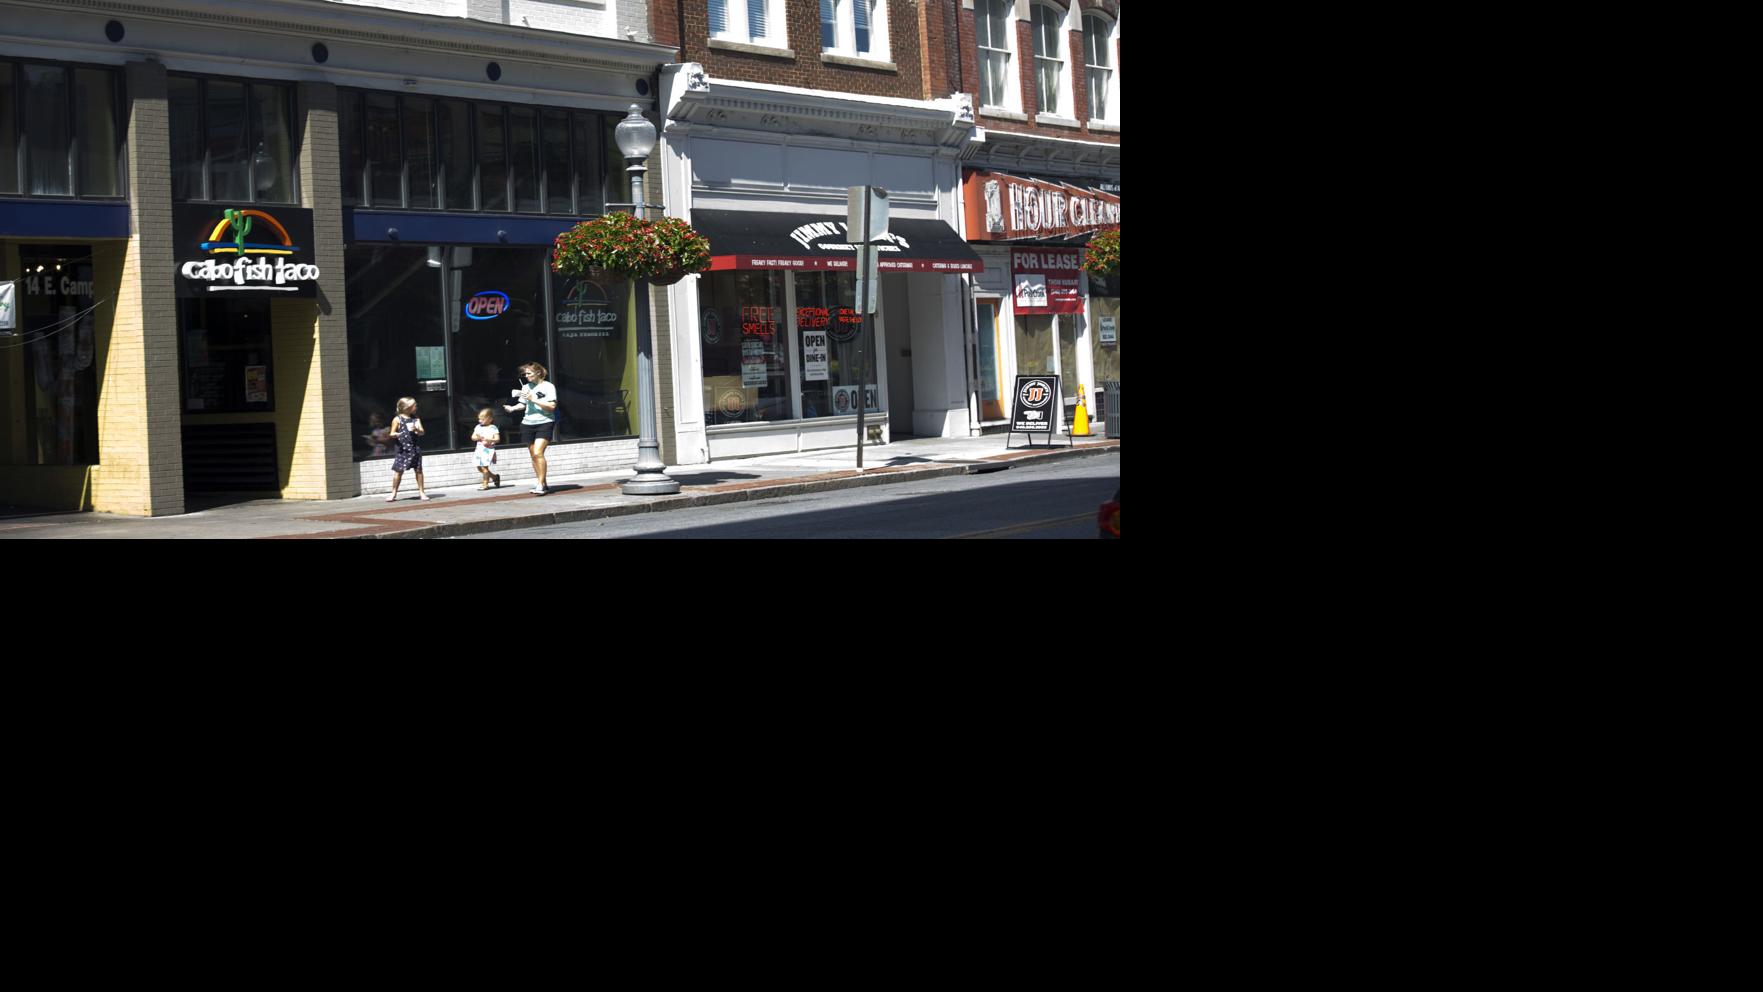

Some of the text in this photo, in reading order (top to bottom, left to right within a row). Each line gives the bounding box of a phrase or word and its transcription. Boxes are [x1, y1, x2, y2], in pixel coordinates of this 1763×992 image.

[984, 180, 1005, 233] 1
[1008, 183, 1067, 231] HOUR
[789, 221, 841, 250] JIMMY
[1013, 252, 1079, 270] FOR LEASE
[181, 256, 320, 285] cabo fish taco
[25, 275, 40, 295] 14
[44, 276, 57, 295] E.
[468, 296, 504, 314] OPEN
[741, 305, 775, 323] FREE
[556, 309, 617, 325] cabo fish taco
[741, 322, 776, 335] SMELLS
[805, 335, 825, 347] OPEN
[806, 353, 827, 363] DINE-IN
[850, 389, 878, 410] OEN
